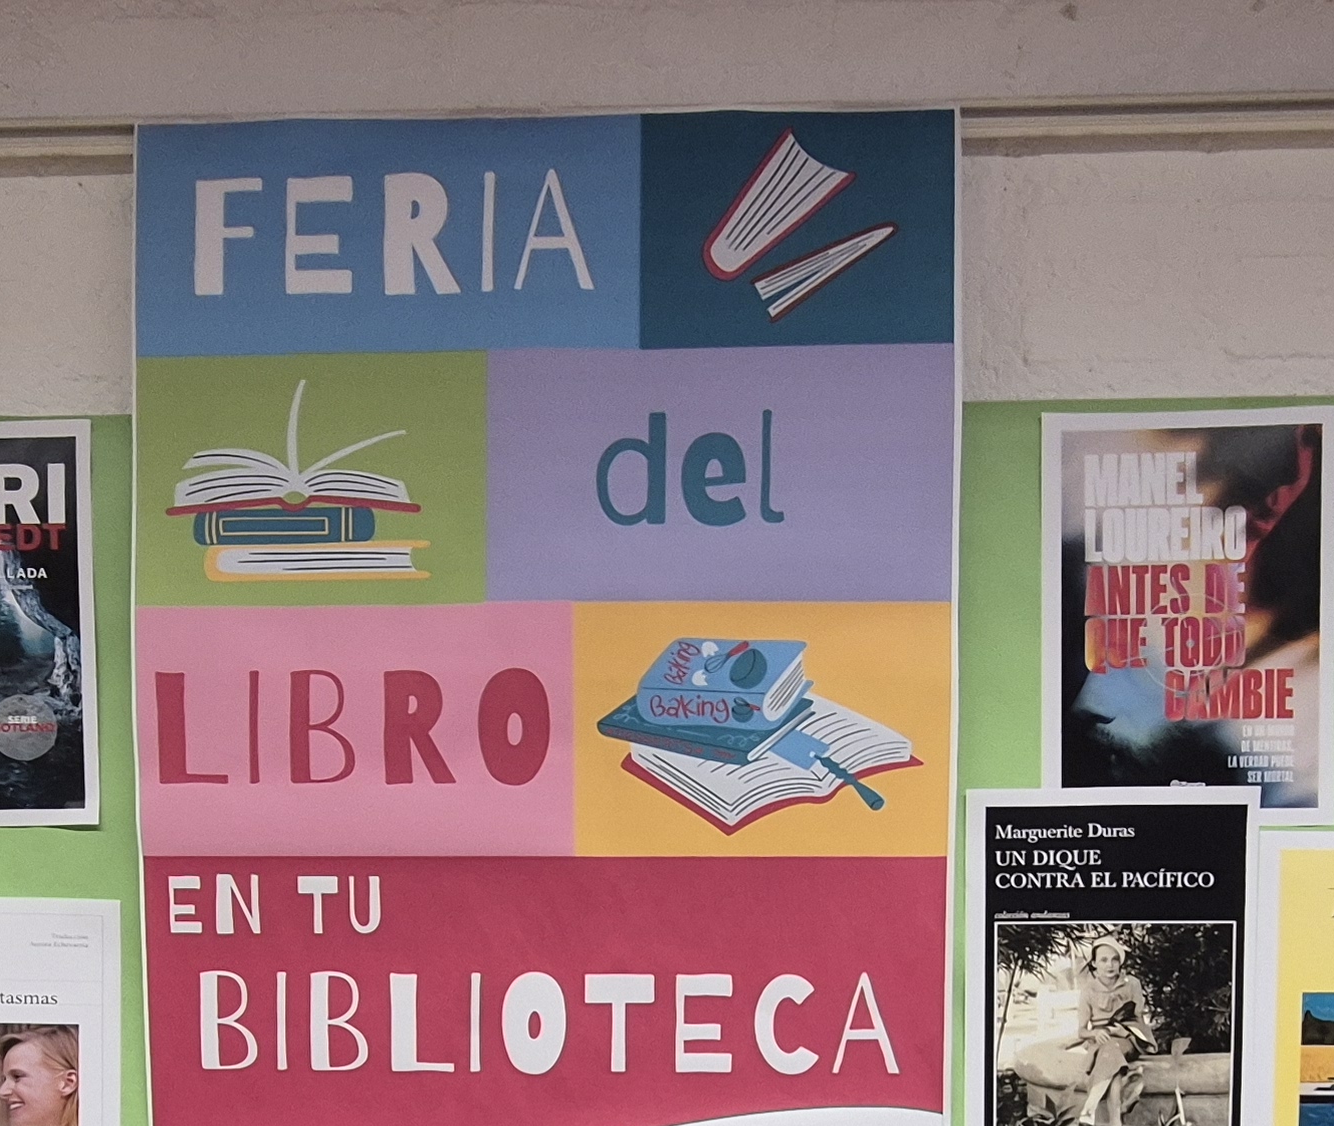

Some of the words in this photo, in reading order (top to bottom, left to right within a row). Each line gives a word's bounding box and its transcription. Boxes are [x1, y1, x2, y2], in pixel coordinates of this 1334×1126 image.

[193, 168, 594, 296] FERIA
[596, 408, 784, 527] del
[1084, 452, 1203, 506] MANEL
[1084, 506, 1247, 562] LOUREIRO
[1084, 564, 1190, 616] ANTES
[1204, 562, 1246, 614] DE
[664, 641, 700, 685] Baking
[1084, 617, 1148, 673] QUE
[1160, 617, 1246, 667] TODO
[650, 695, 730, 723] Baking
[1164, 668, 1294, 720] CAMBIE
[155, 667, 550, 785] LIBRO
[995, 824, 1083, 843] Marguerite
[1088, 823, 1135, 838] Duras
[168, 874, 262, 935] EN
[298, 875, 382, 934] TU
[995, 873, 1085, 889] CONTRA
[1091, 872, 1116, 888] EL
[1122, 868, 1214, 888] PACÍFICO
[198, 970, 900, 1075] BIBLIOTECA
